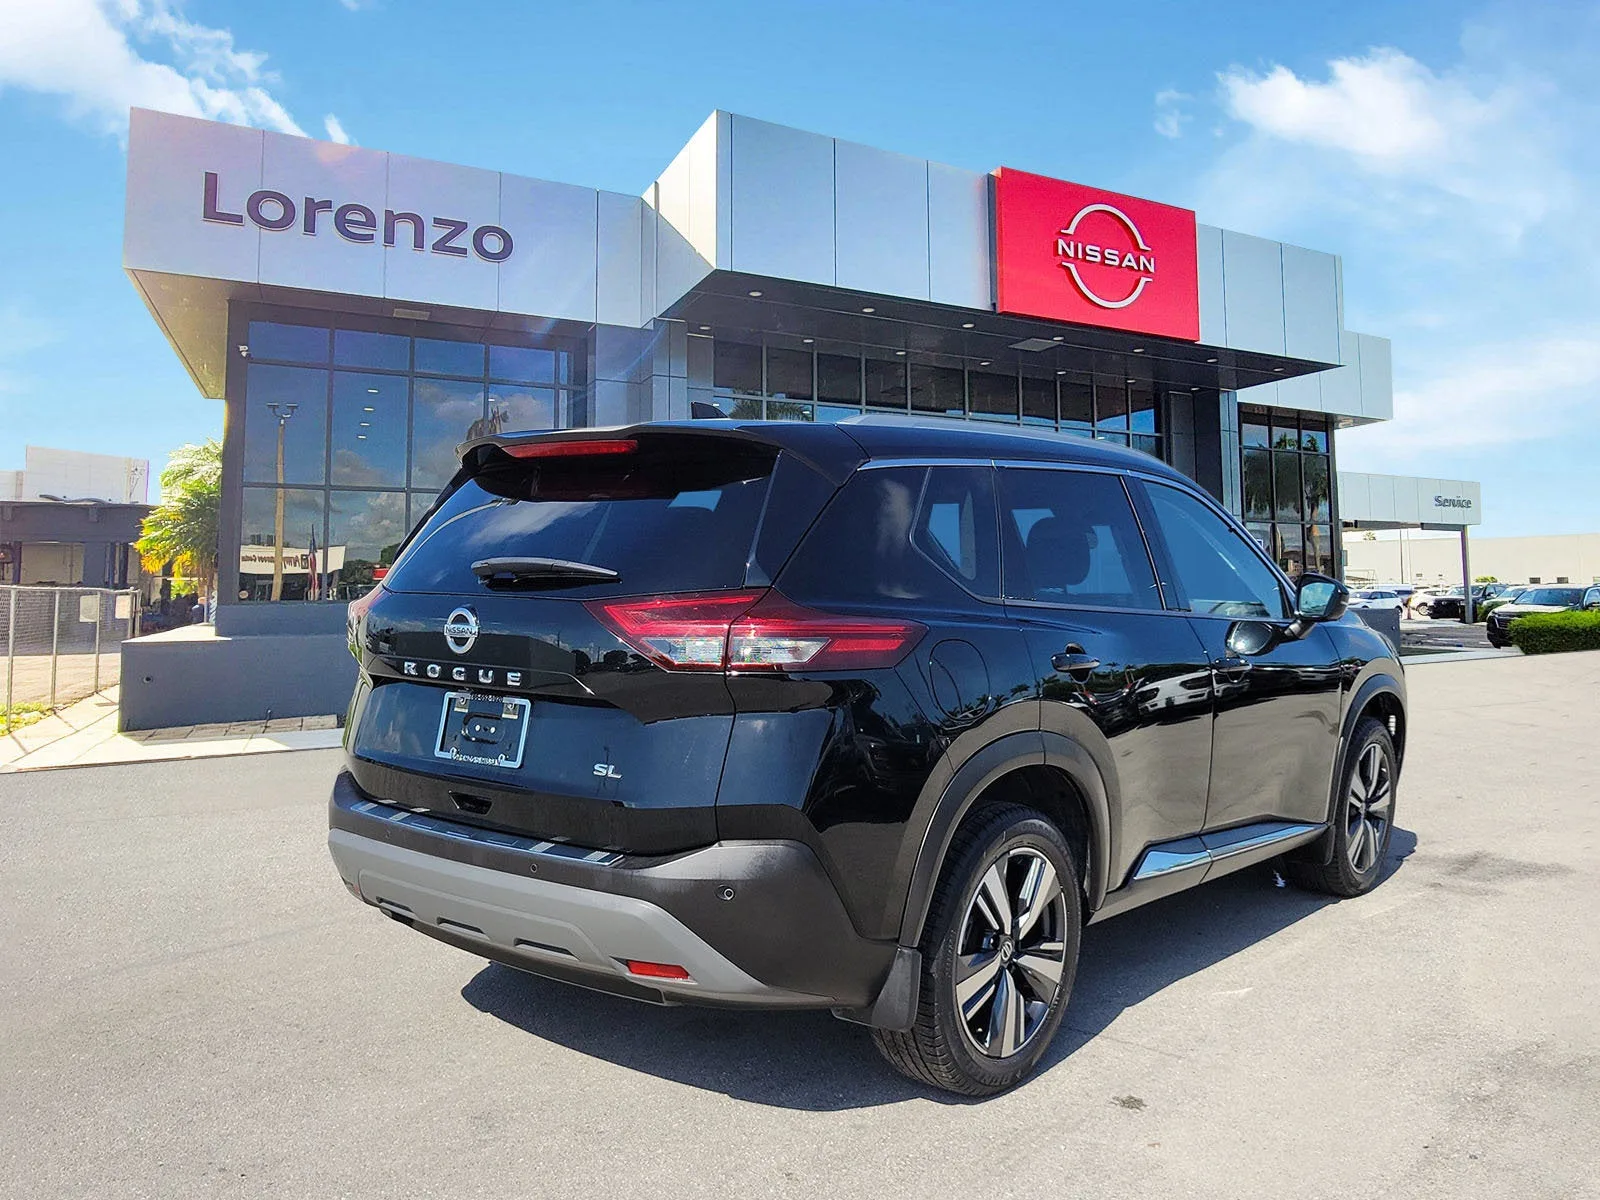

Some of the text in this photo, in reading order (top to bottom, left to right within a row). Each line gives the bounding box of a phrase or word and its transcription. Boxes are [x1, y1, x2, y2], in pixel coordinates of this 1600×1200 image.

[202, 171, 514, 262] Lorenzo
[1057, 238, 1155, 273] NISSAN
[1434, 495, 1472, 508] Service
[446, 624, 473, 635] NISSAN
[404, 661, 521, 686] ROGUE
[593, 763, 623, 779] SL
